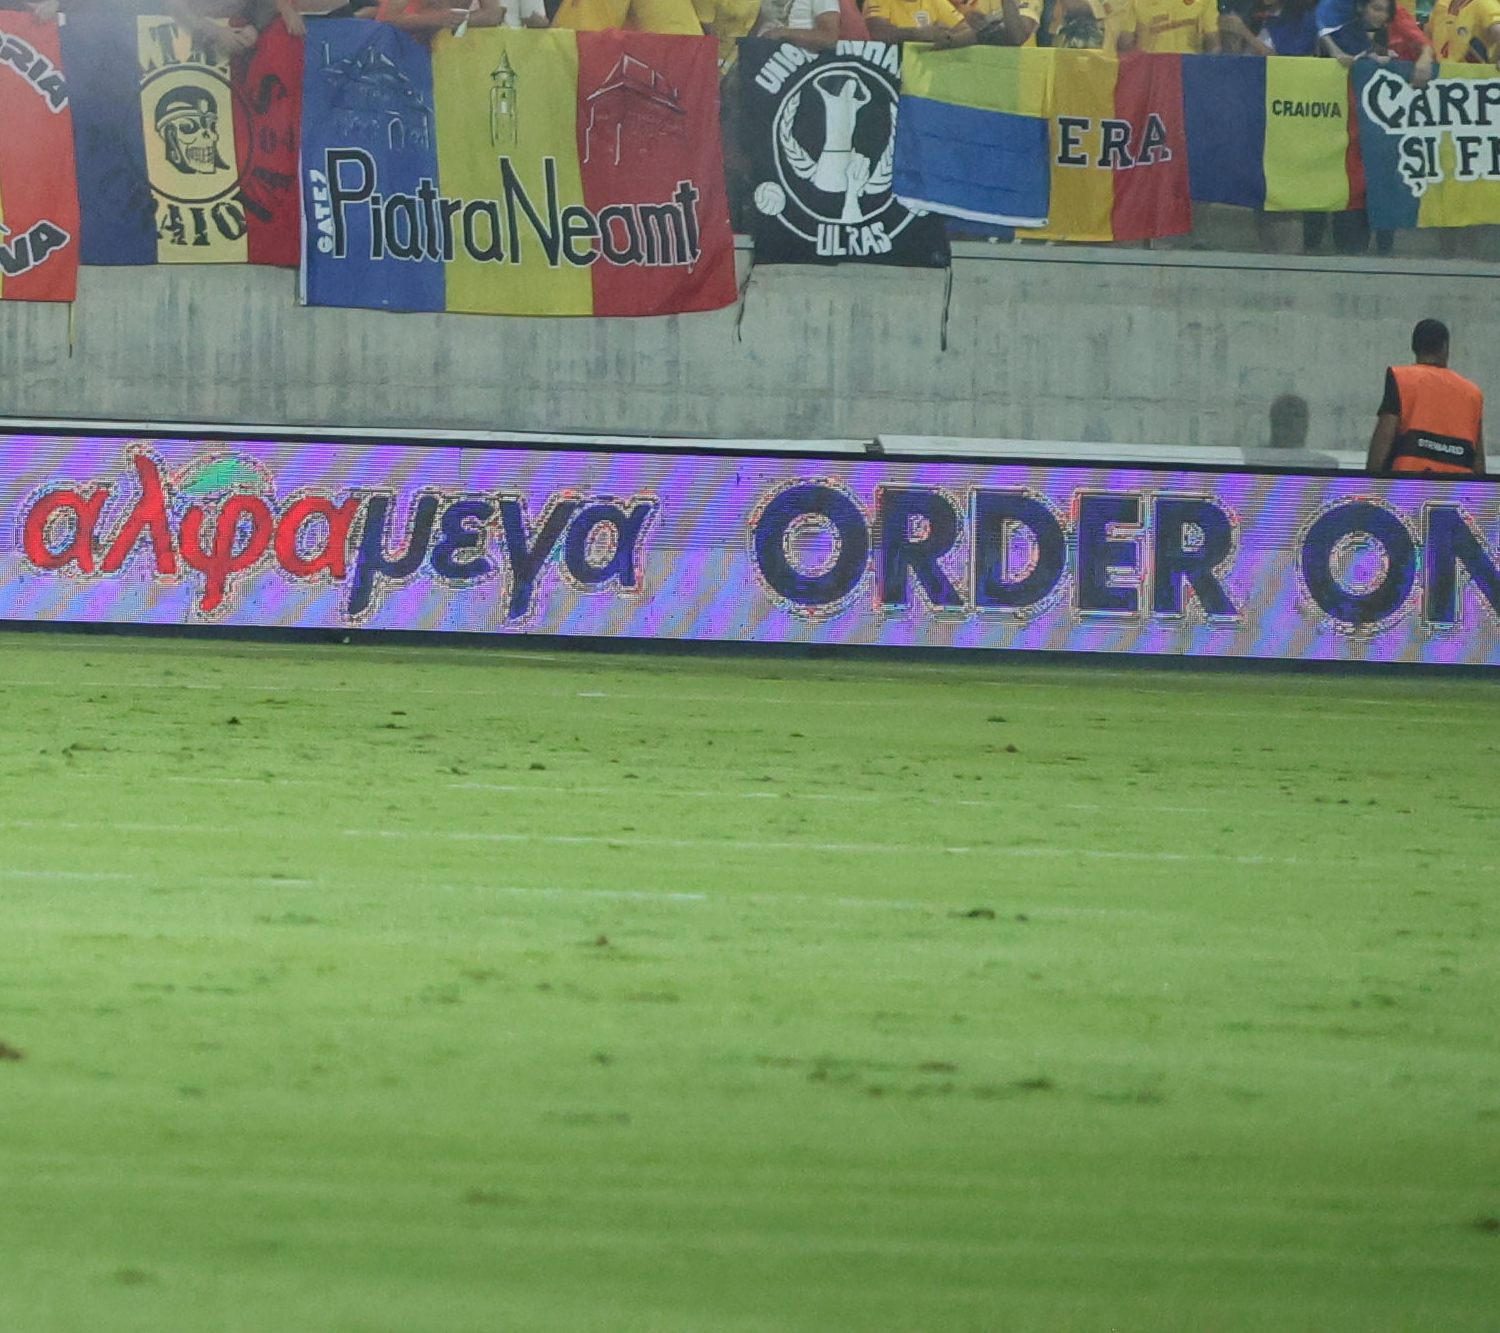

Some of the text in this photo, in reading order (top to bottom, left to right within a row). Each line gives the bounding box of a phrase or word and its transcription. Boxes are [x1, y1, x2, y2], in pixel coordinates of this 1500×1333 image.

[1271, 98, 1343, 119] CRAIOVA
[1417, 437, 1464, 456] STEWARD
[748, 478, 1242, 623] ORDER
